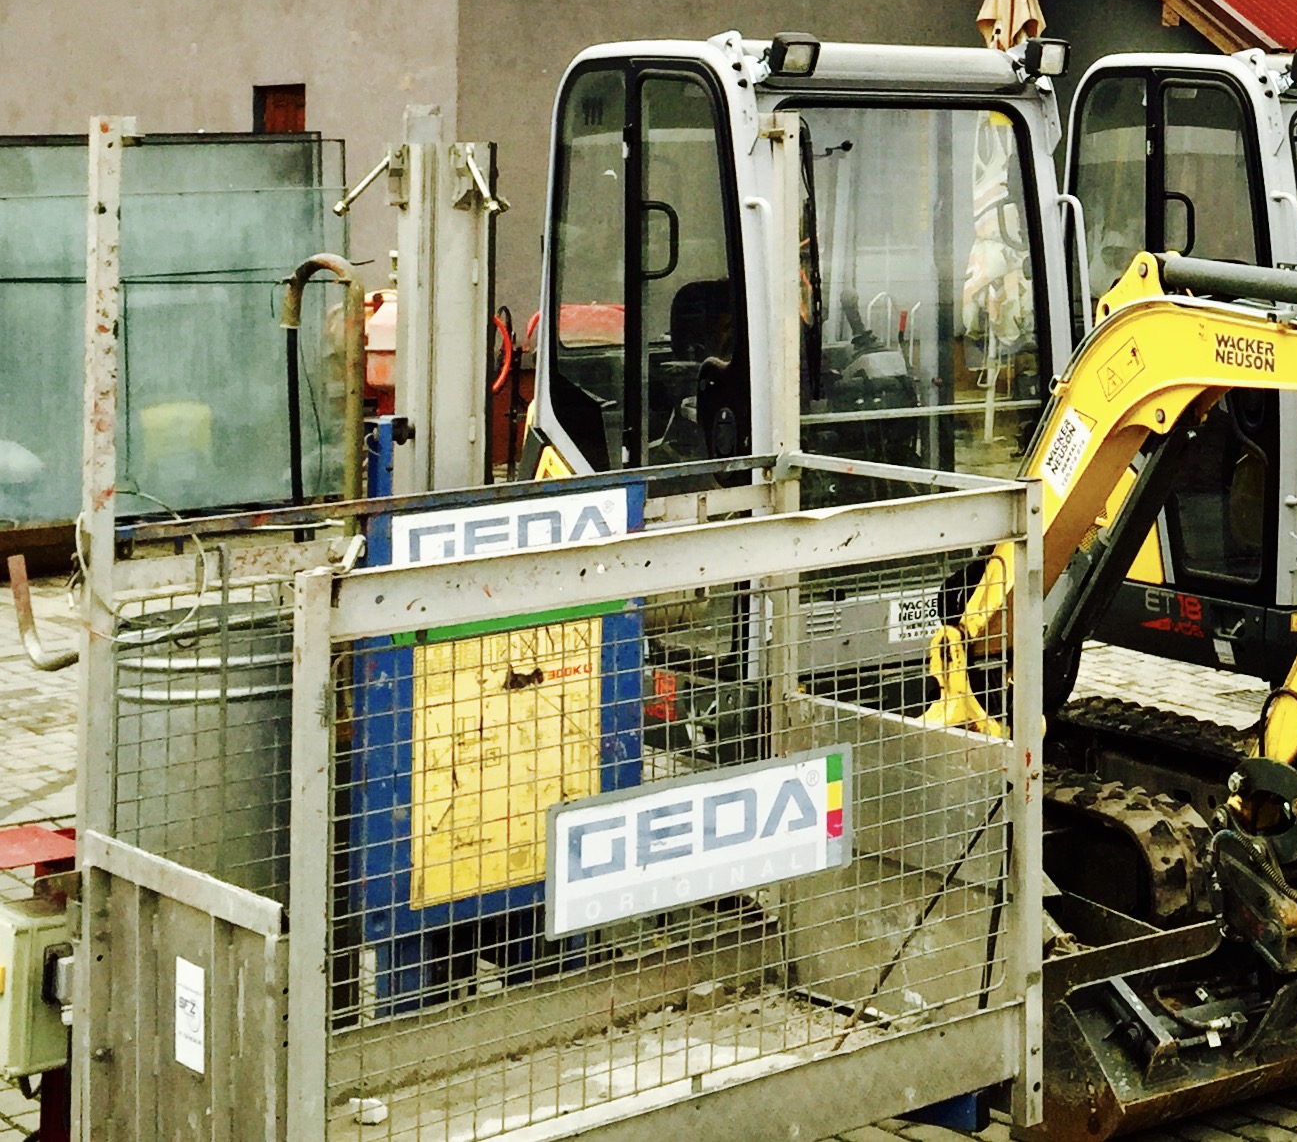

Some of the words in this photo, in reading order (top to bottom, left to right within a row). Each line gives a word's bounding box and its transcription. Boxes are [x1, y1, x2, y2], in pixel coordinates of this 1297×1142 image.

[1215, 333, 1275, 357] WACKER
[1215, 348, 1275, 372] NEUSON
[1046, 419, 1071, 466] WACKER
[1051, 426, 1077, 475] NEUSON
[898, 599, 938, 611] WACKE
[898, 608, 937, 622] NEUSO
[567, 777, 818, 884] GEDA
[585, 852, 808, 920] ORIGINAL
